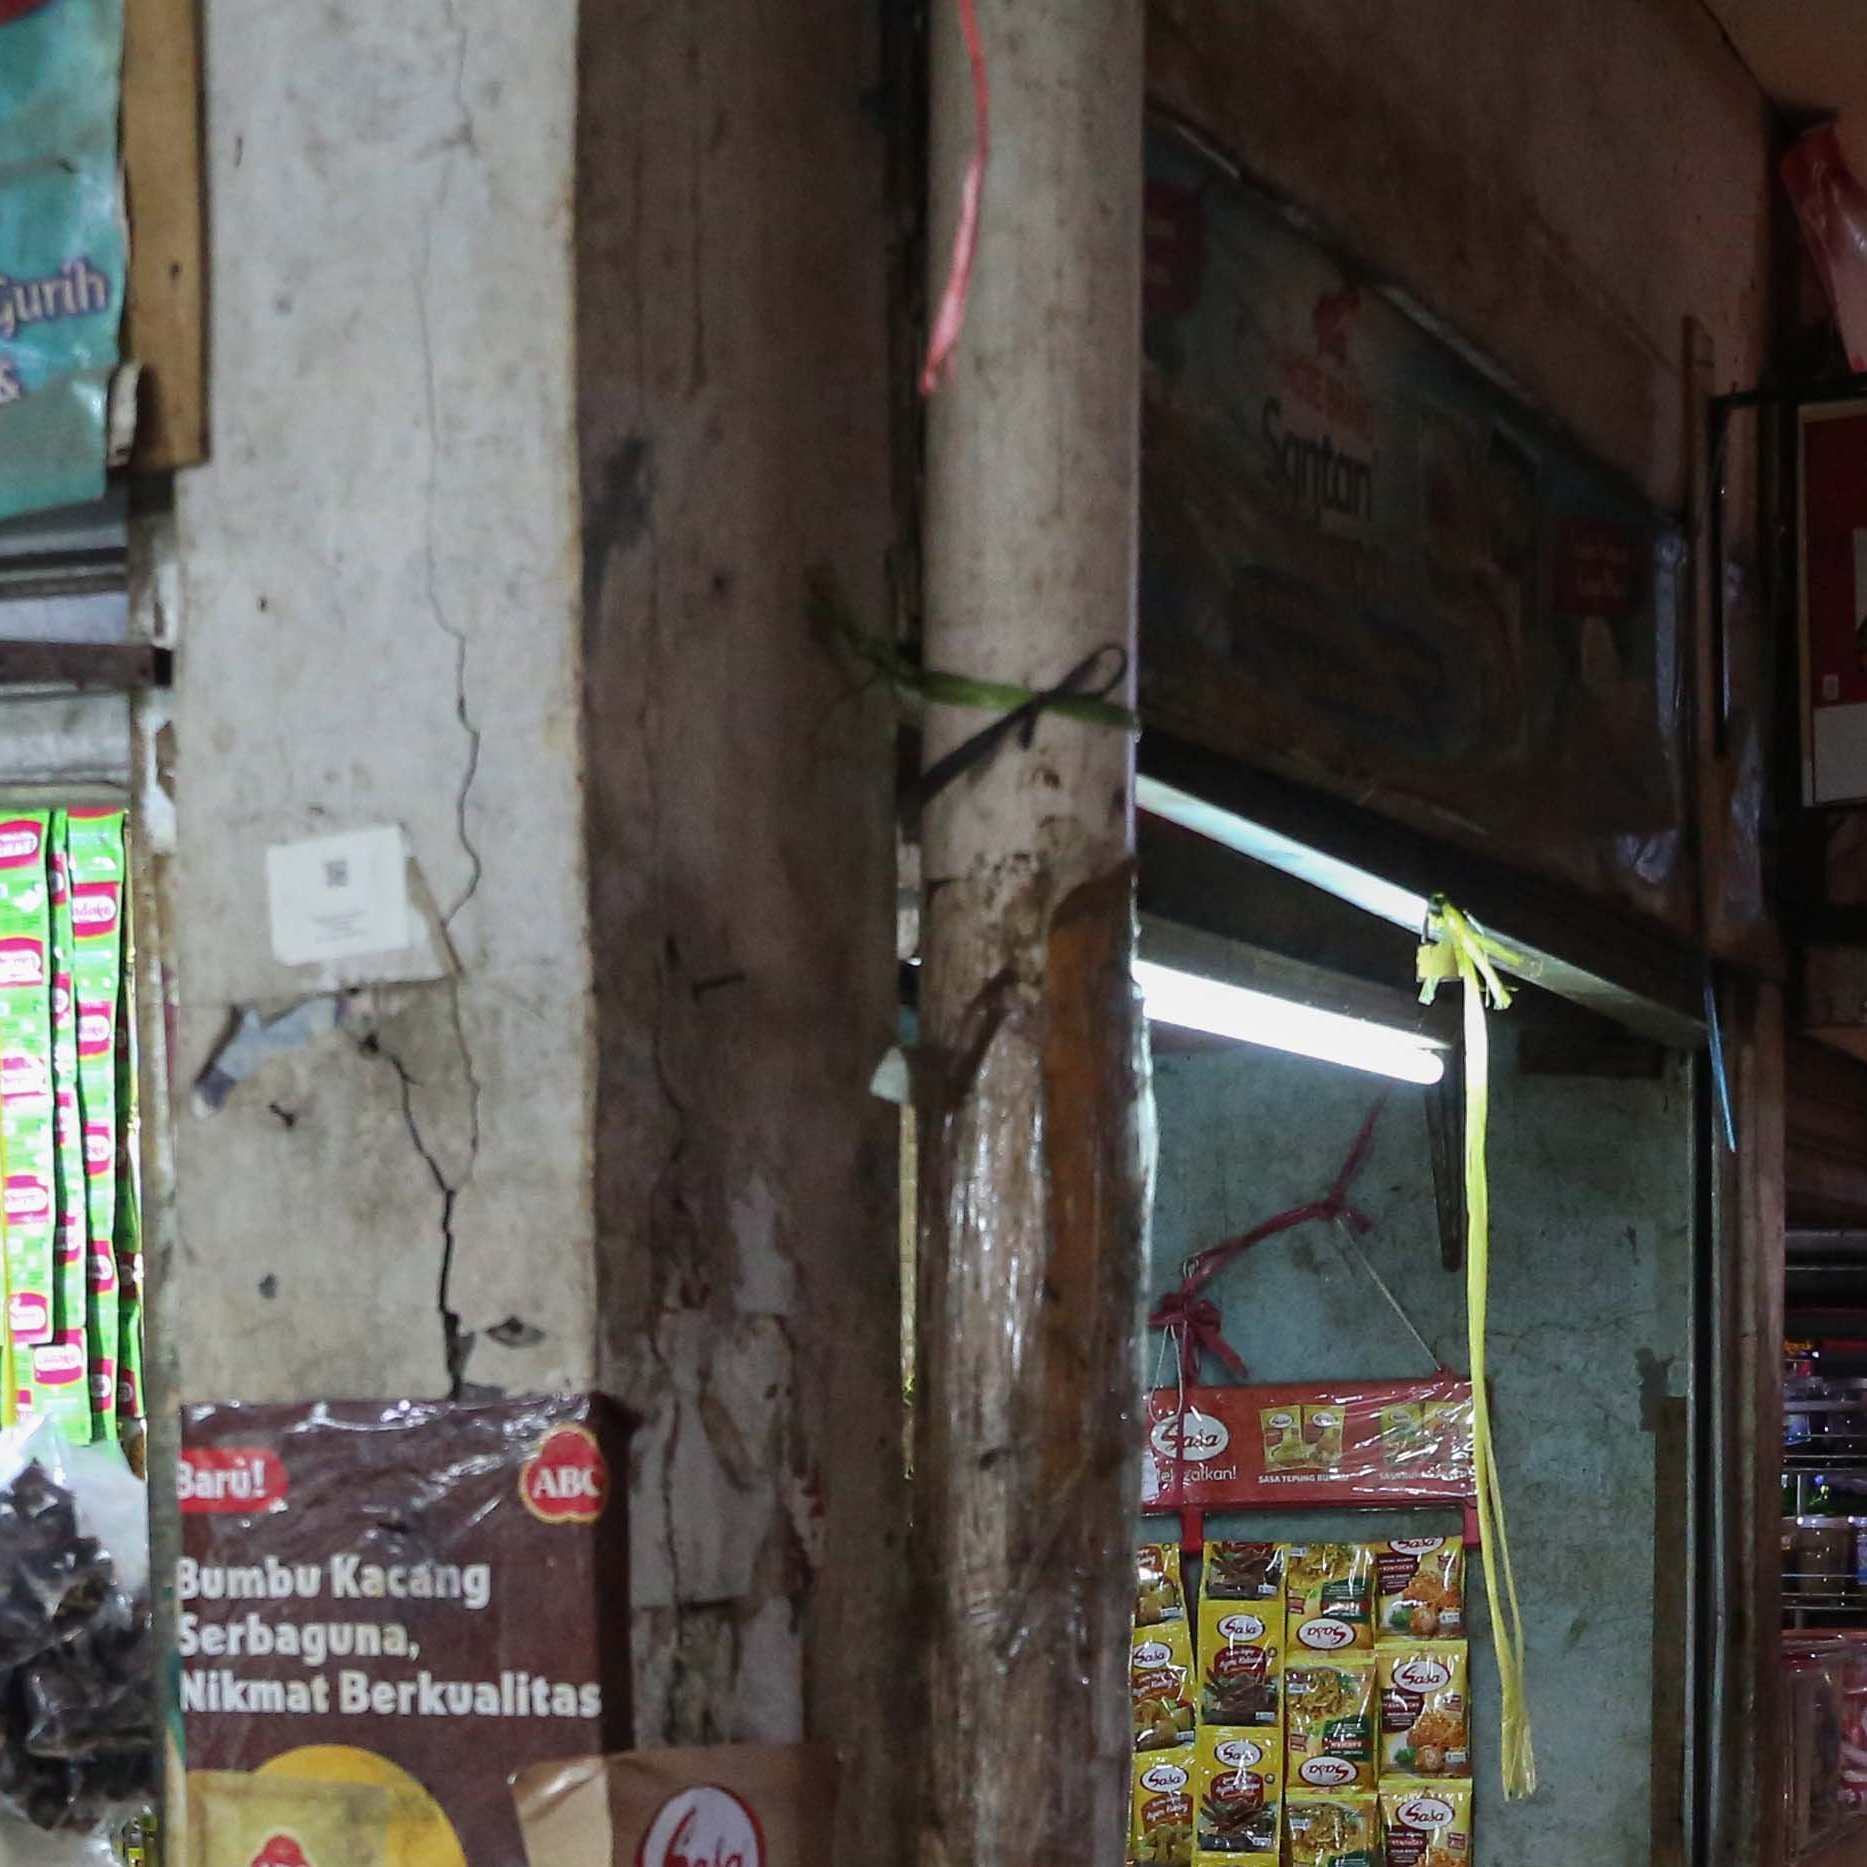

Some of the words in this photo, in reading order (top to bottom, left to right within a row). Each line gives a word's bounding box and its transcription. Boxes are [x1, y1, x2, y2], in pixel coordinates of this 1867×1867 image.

[1155, 1418, 1219, 1450] Sasa
[533, 1464, 600, 1499] ABC
[179, 1556, 321, 1600] Bumbu
[333, 1556, 491, 1608] Kacang
[1224, 1617, 1258, 1636] Sasa
[1307, 1625, 1347, 1645] Sasa
[179, 1614, 419, 1665] Serbaguna,
[1401, 1668, 1443, 1685] Sasa
[179, 1672, 329, 1713] Nikmat
[339, 1671, 601, 1718] Berkualitas
[1149, 1771, 1182, 1786] Sasa
[1308, 1762, 1350, 1781] Sasa
[1406, 1803, 1445, 1823] Sasa
